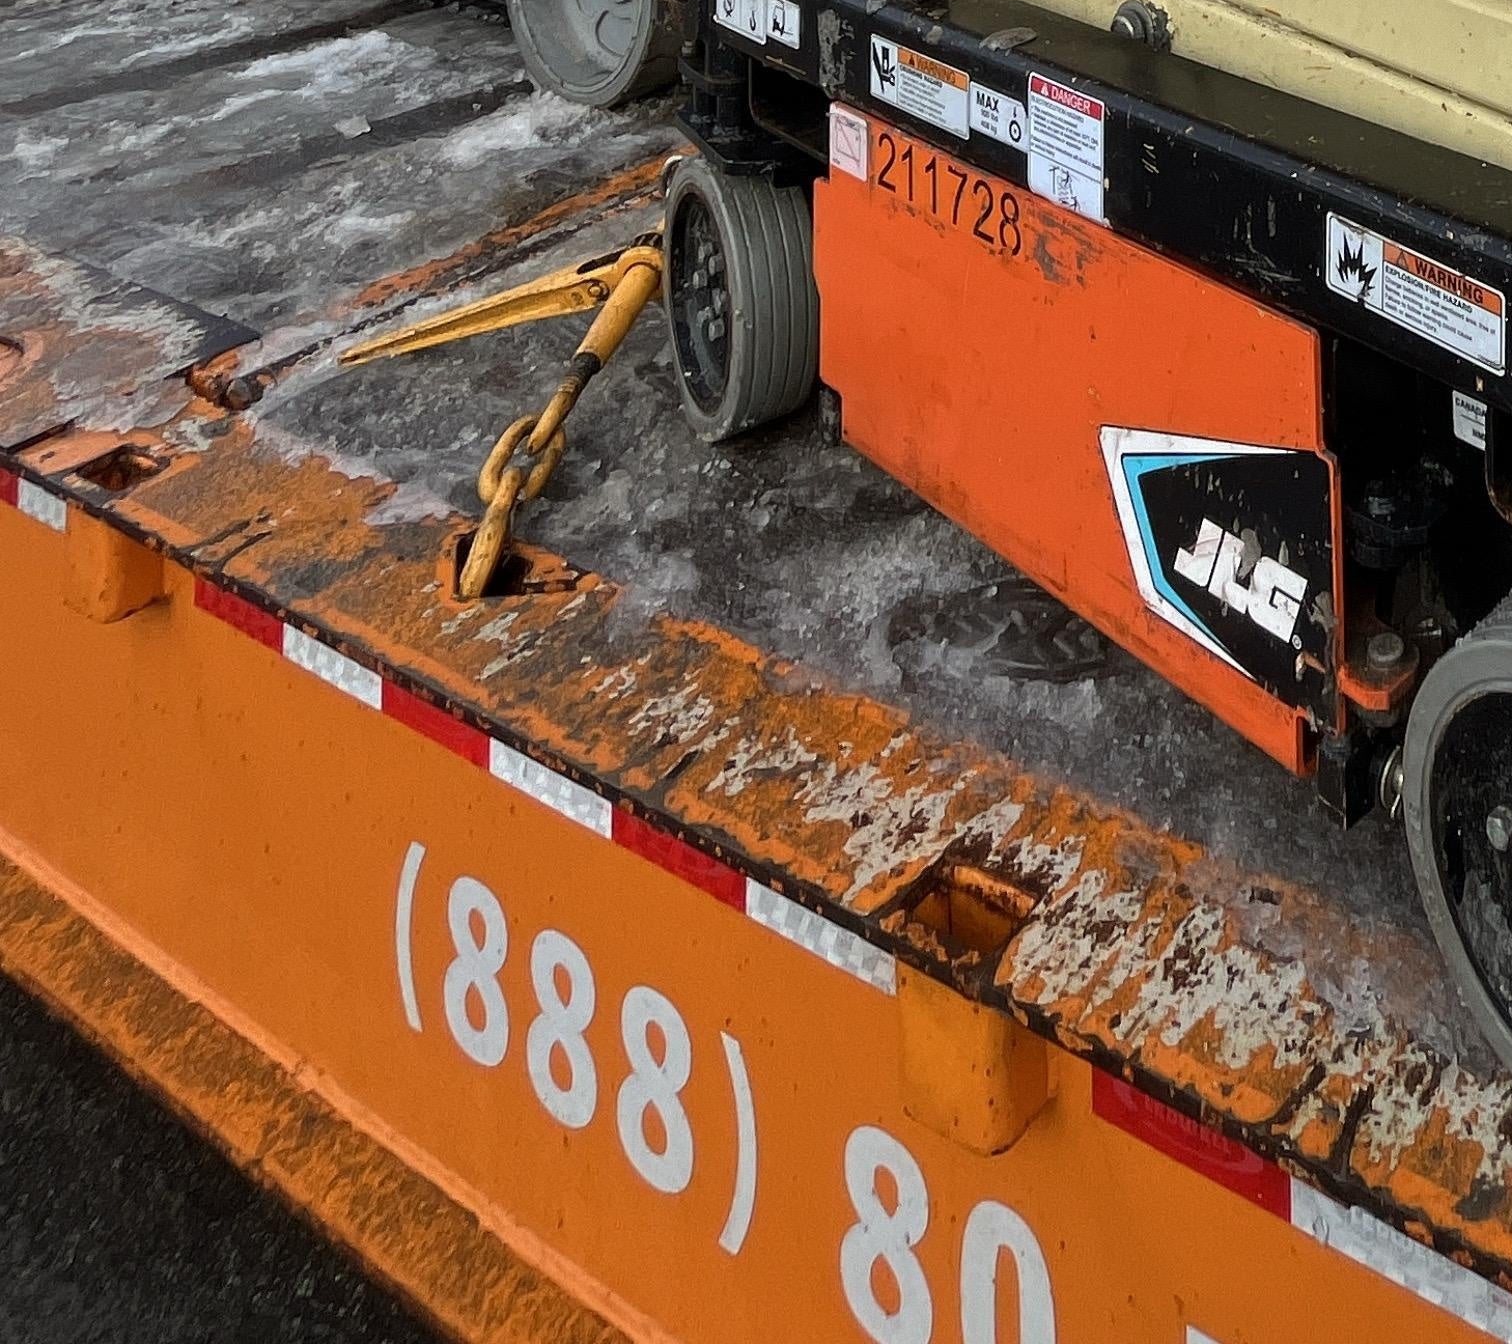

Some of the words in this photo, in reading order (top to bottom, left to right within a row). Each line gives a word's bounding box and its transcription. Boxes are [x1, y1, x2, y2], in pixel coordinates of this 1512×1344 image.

[975, 90, 1000, 113] MAX
[1051, 87, 1091, 115] DANGER
[876, 131, 1022, 257] 211728
[1414, 257, 1484, 305] WARNING
[1173, 517, 1309, 644] JLG
[394, 840, 758, 1257] (888)
